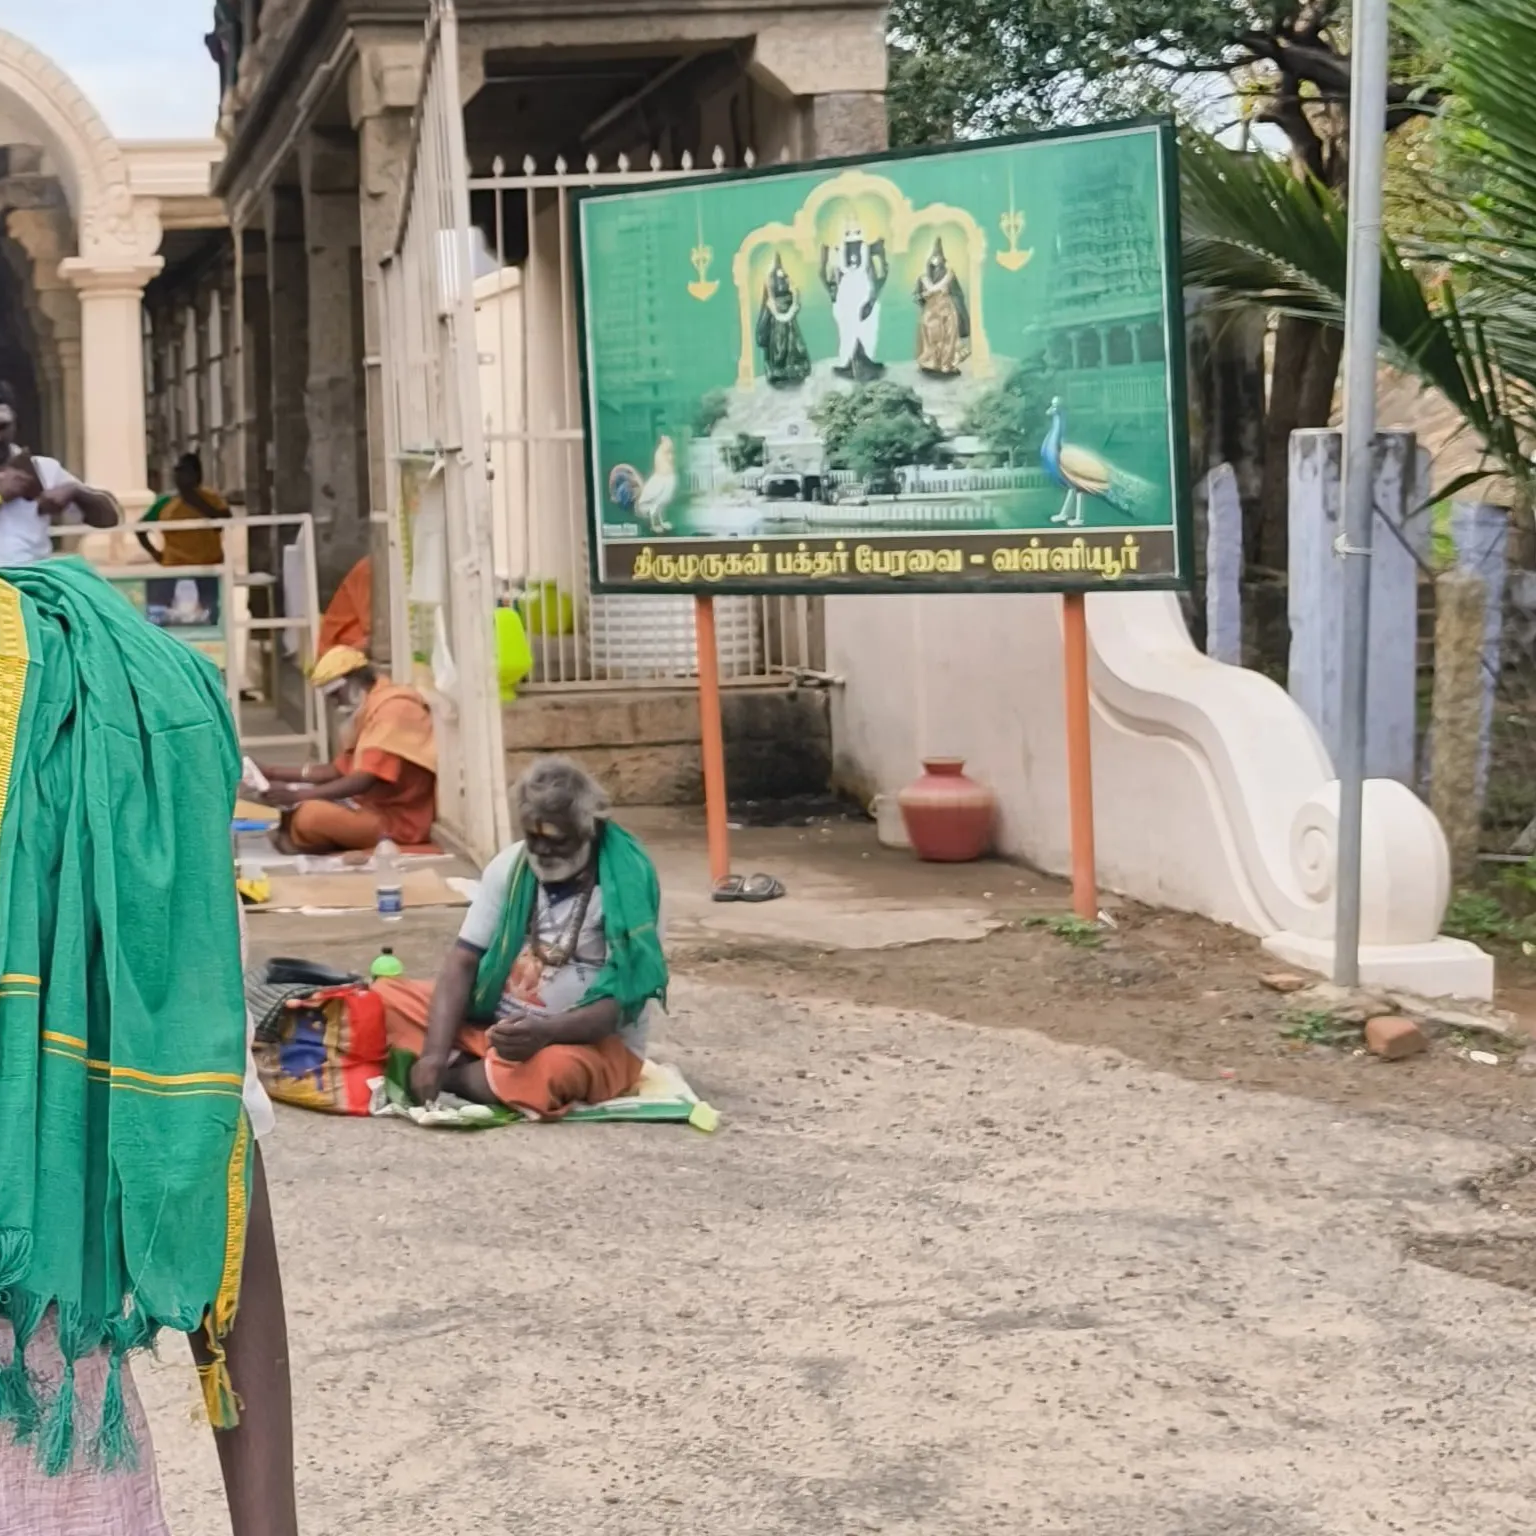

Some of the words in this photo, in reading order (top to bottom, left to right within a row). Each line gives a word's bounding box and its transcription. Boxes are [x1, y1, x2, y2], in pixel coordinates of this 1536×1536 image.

[632, 543, 769, 583] திருமுருகன்
[775, 541, 849, 578] பக்தர்
[855, 544, 962, 577] பேரவை
[992, 534, 1140, 580] வள்ளியூர்
